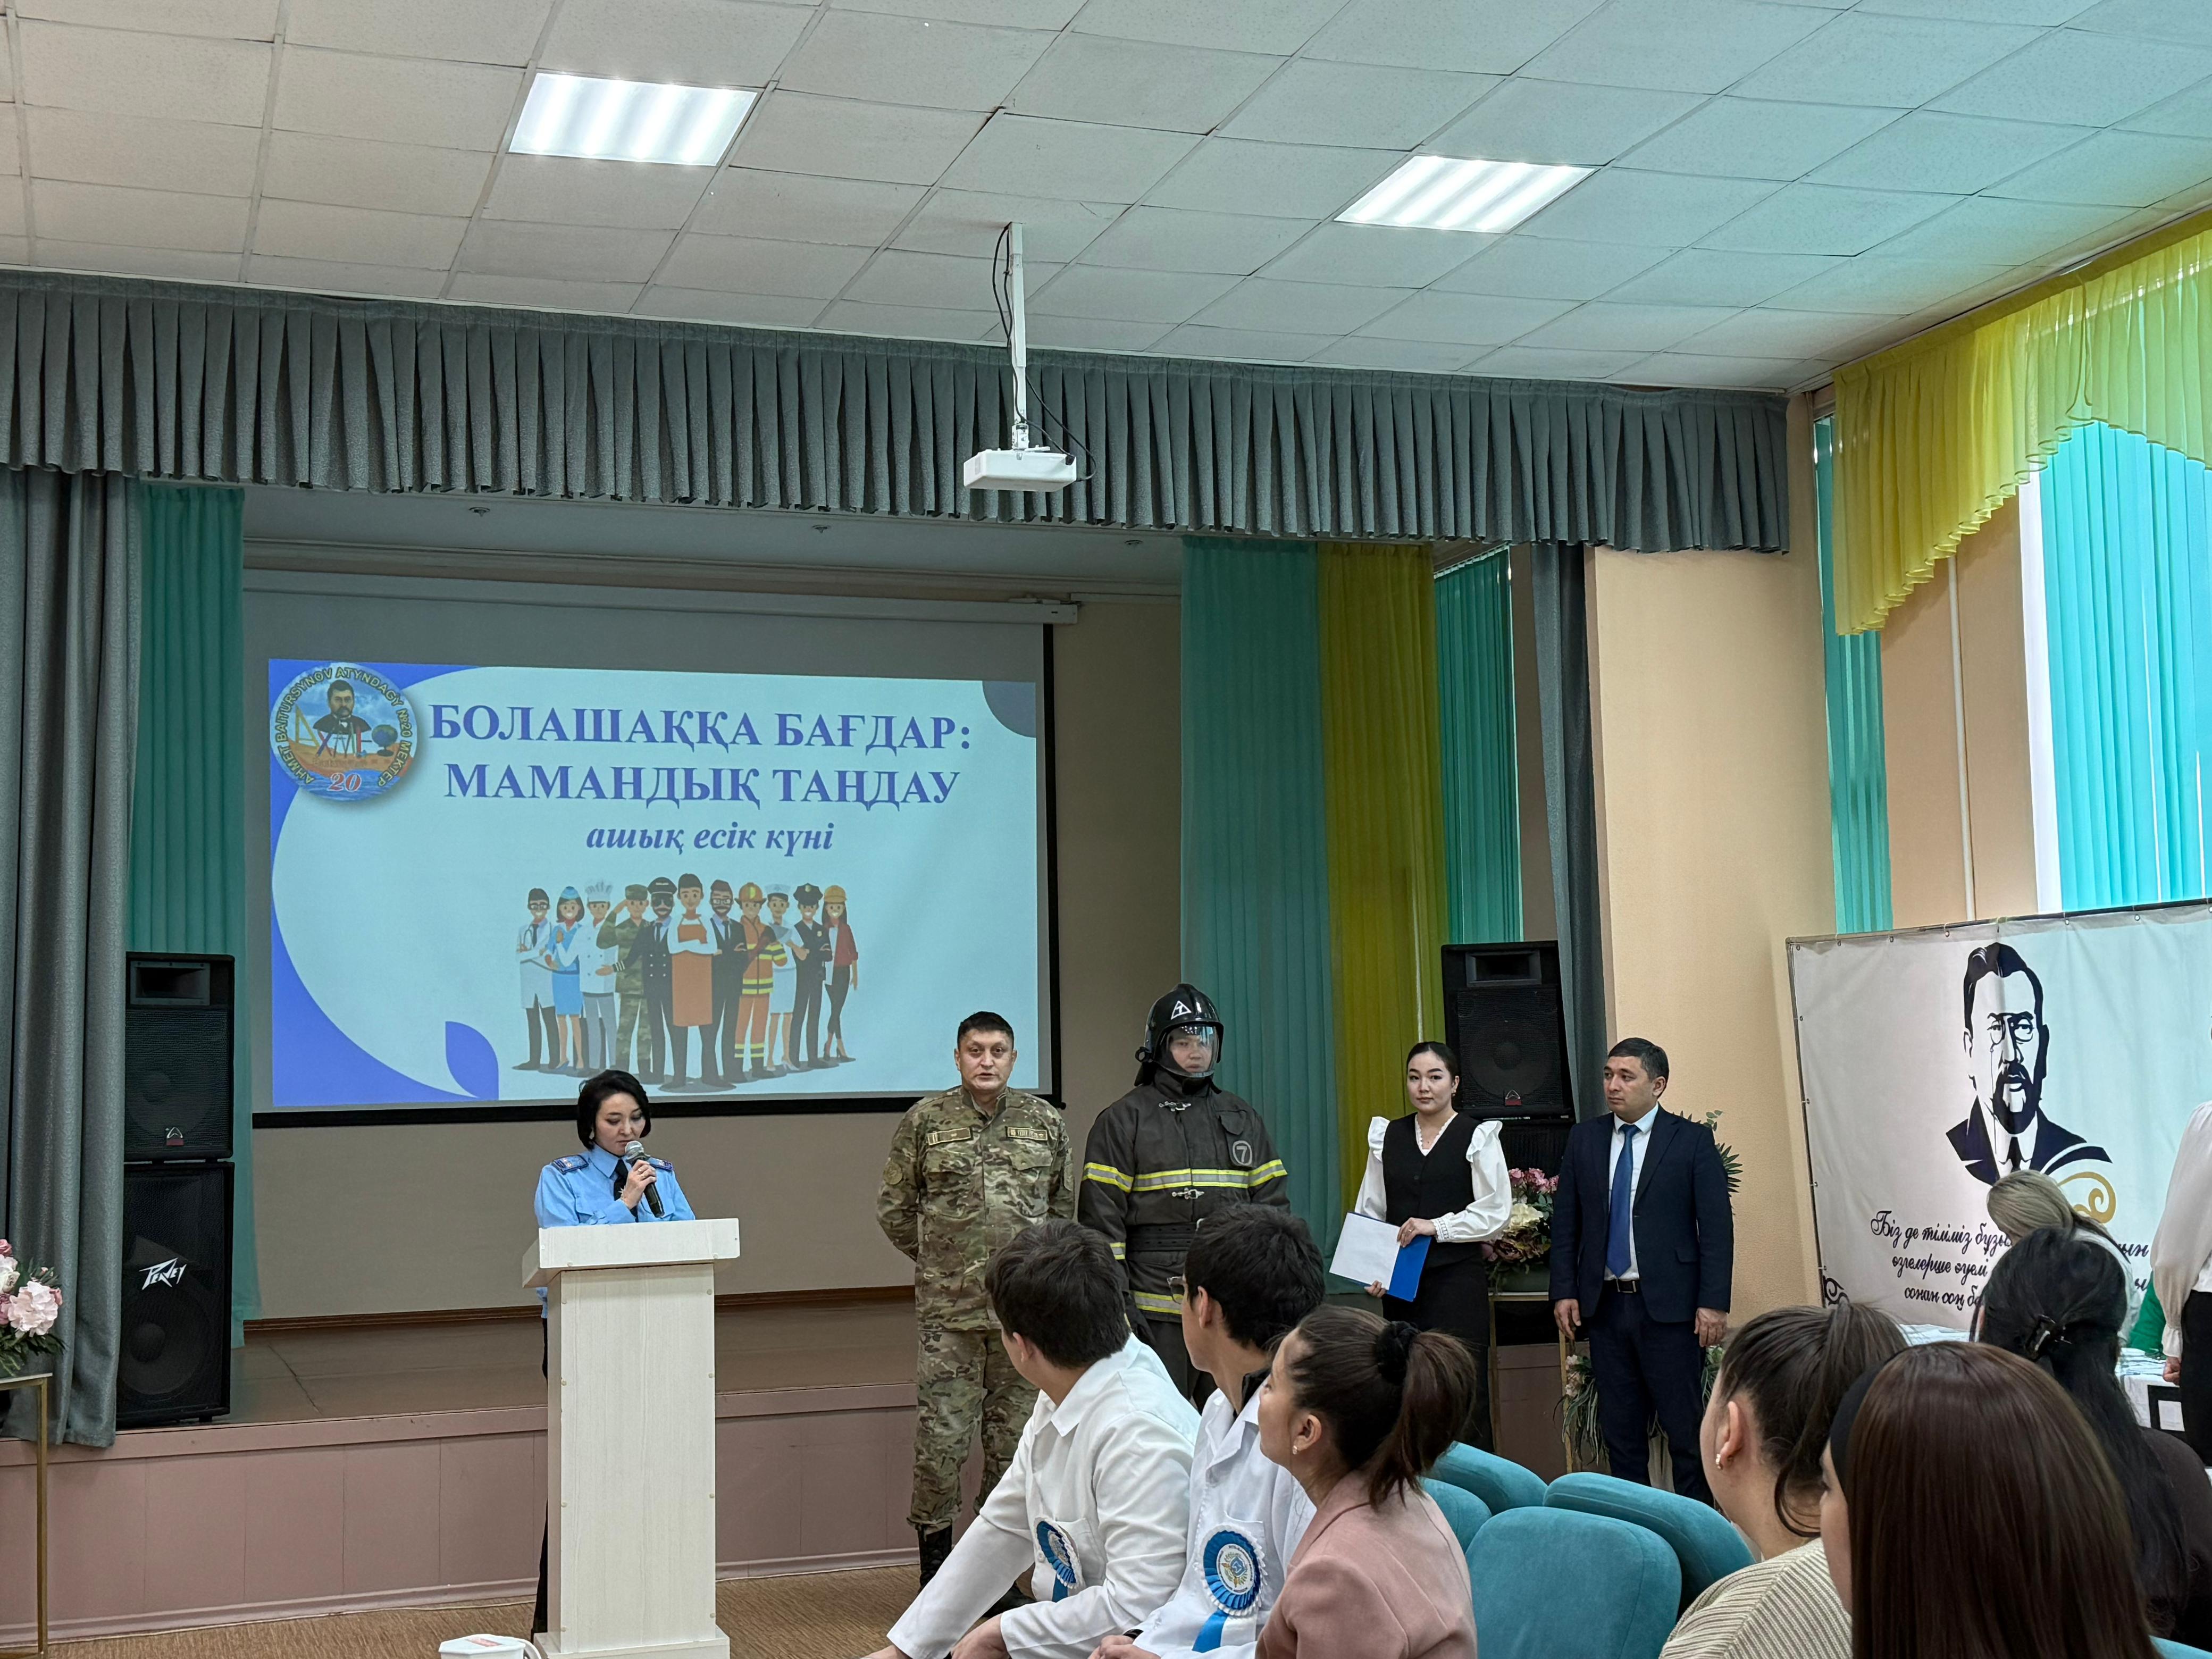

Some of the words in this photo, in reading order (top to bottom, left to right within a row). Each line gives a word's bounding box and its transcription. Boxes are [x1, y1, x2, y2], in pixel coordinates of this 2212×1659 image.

[274, 667, 333, 743] BAITURSYNOV
[335, 666, 405, 707] ATYNDAGY
[428, 704, 763, 753] БОЛАШАҚҚА
[774, 713, 970, 757] БАҒДАР:
[277, 744, 316, 785] AHMET
[326, 772, 362, 792] 20
[378, 740, 413, 787] MEKTEP
[443, 763, 760, 810] МАМАНДЫҚ
[772, 769, 961, 812] ТАҢДАУ
[586, 828, 685, 855] ашық
[693, 822, 757, 849] есік
[765, 822, 834, 857] күні
[1236, 1145, 1247, 1163] 7
[1871, 1210, 1902, 1249] Біз
[1903, 1227, 1919, 1249] де
[1922, 1223, 1972, 1254] тіліміз
